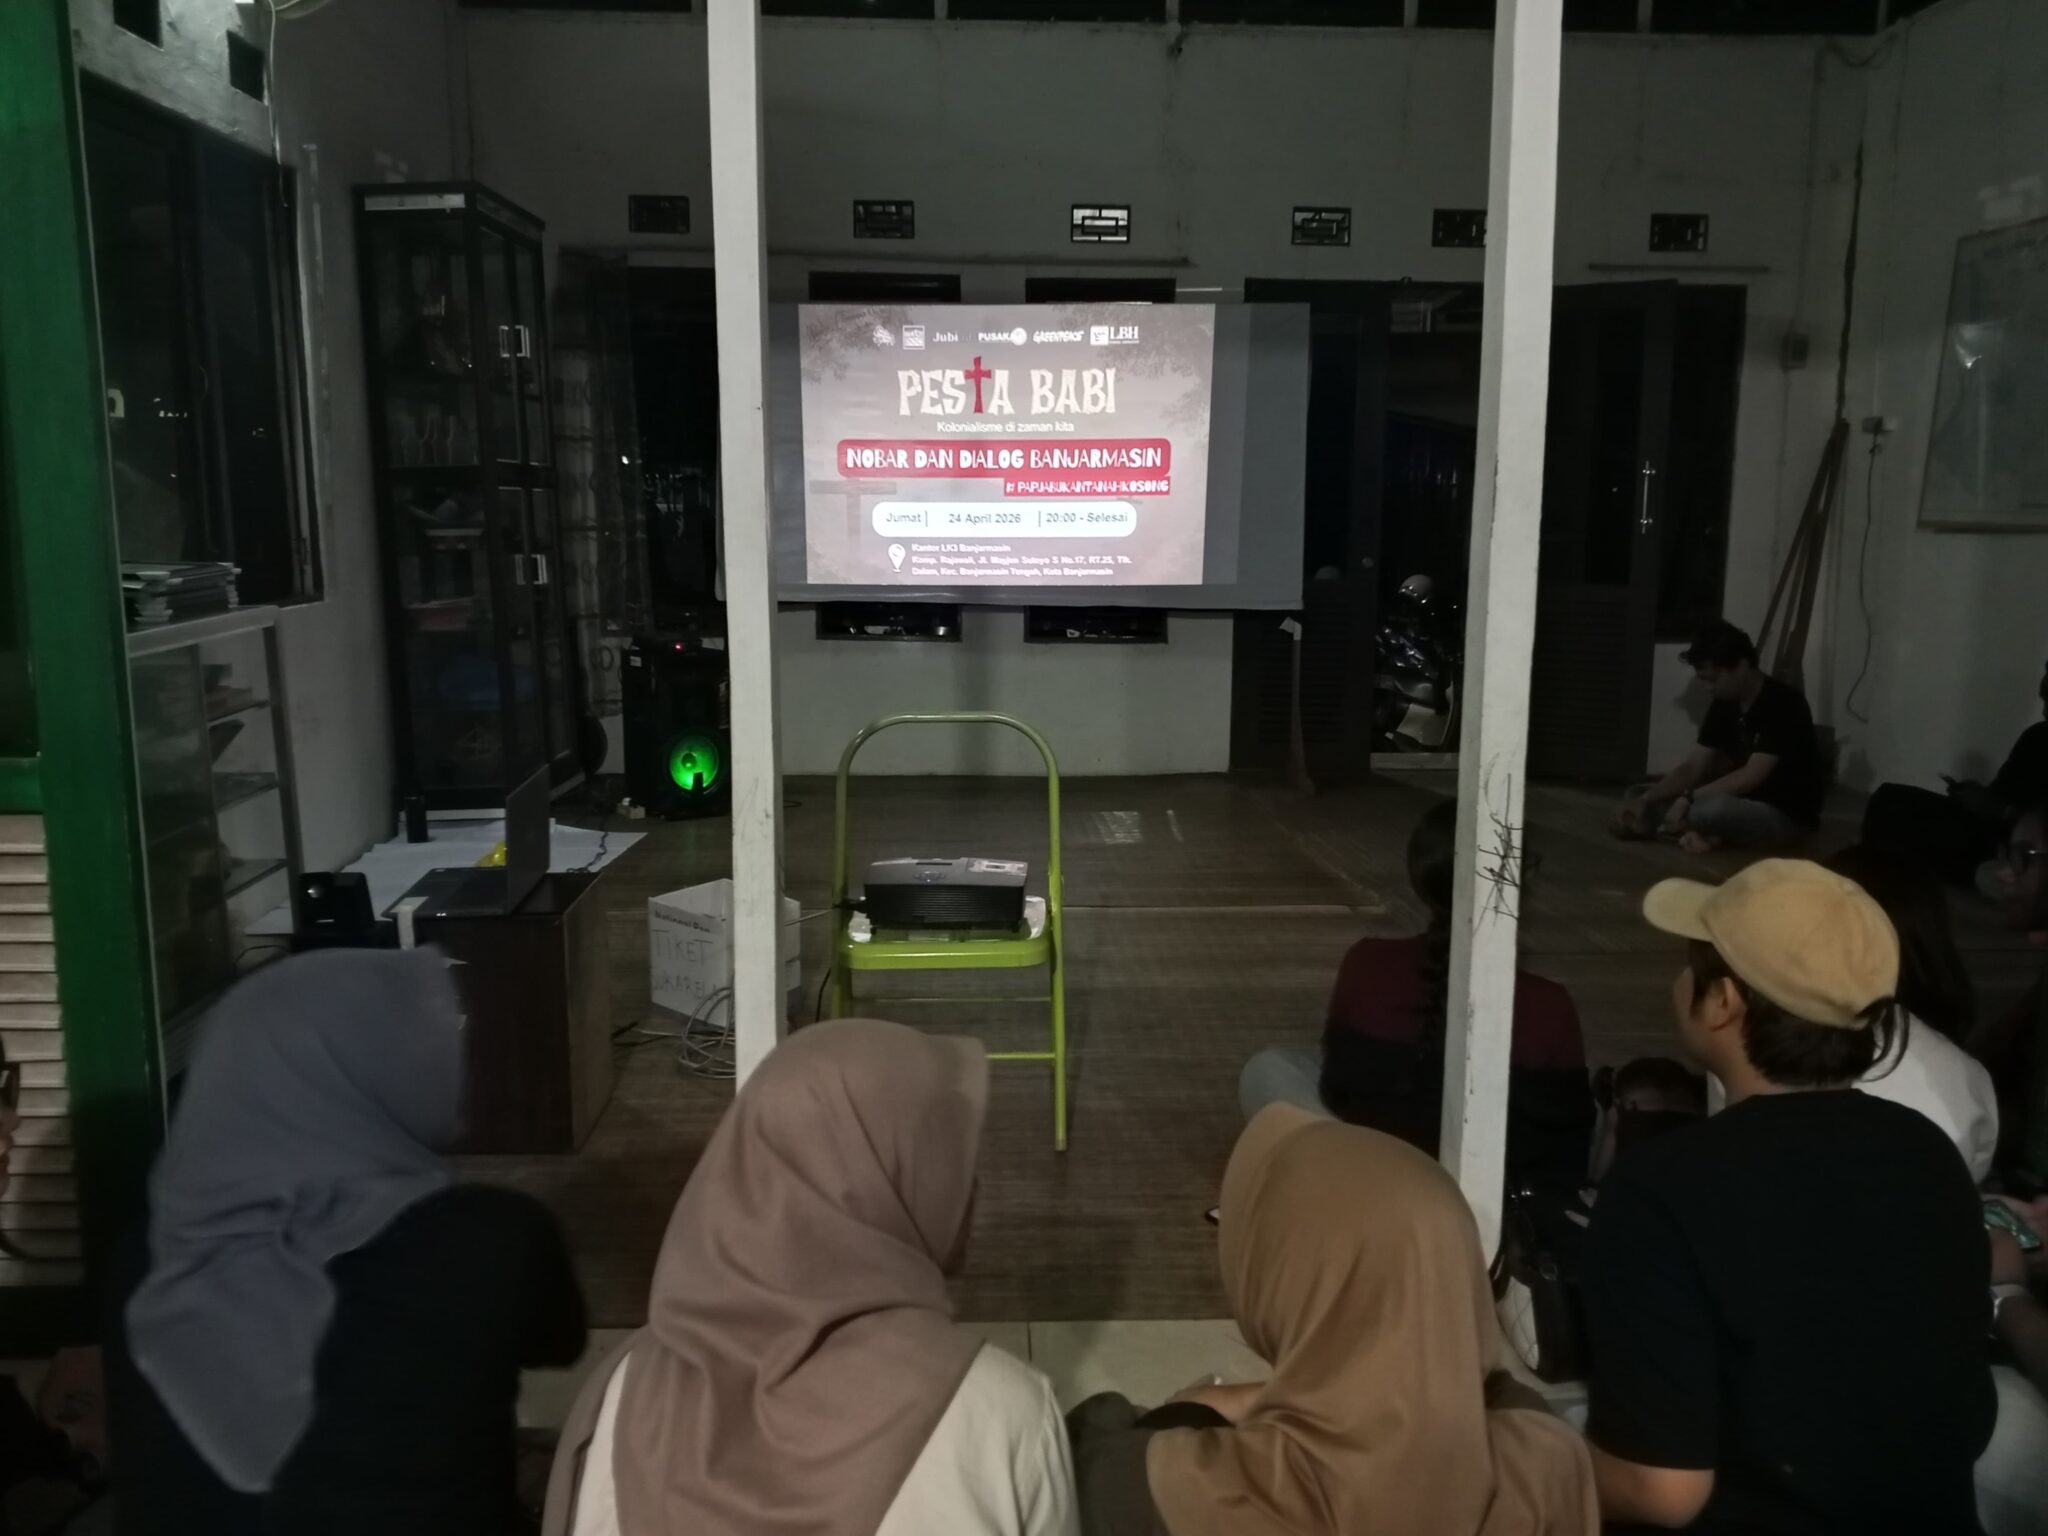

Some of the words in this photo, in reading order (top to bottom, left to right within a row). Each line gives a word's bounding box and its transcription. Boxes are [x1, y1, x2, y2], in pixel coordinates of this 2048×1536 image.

[933, 332, 959, 343] Jubi
[1109, 326, 1138, 340] LBH
[897, 356, 1015, 416] PESTA
[1030, 368, 1116, 415] BABI
[936, 421, 1003, 433] Kolonialisme
[1005, 421, 1016, 433] di
[1017, 423, 1053, 433] zaman
[1055, 421, 1075, 433] kita
[846, 448, 909, 469] NOBAR
[914, 448, 954, 469] DAN
[959, 449, 1024, 469] DIALOG
[1030, 447, 1162, 469] BANJARMASIN
[885, 512, 922, 524] Jumat
[948, 513, 962, 524] 24
[965, 513, 993, 526] April
[995, 513, 1022, 524] 2026
[1046, 512, 1077, 524] 20:00
[1086, 511, 1129, 524] Selesai
[911, 543, 940, 553] Kantor
[959, 543, 1012, 555] Banjarmasin
[959, 567, 1010, 577] Banjarmasin
[1063, 567, 1114, 577] Banjarmasin
